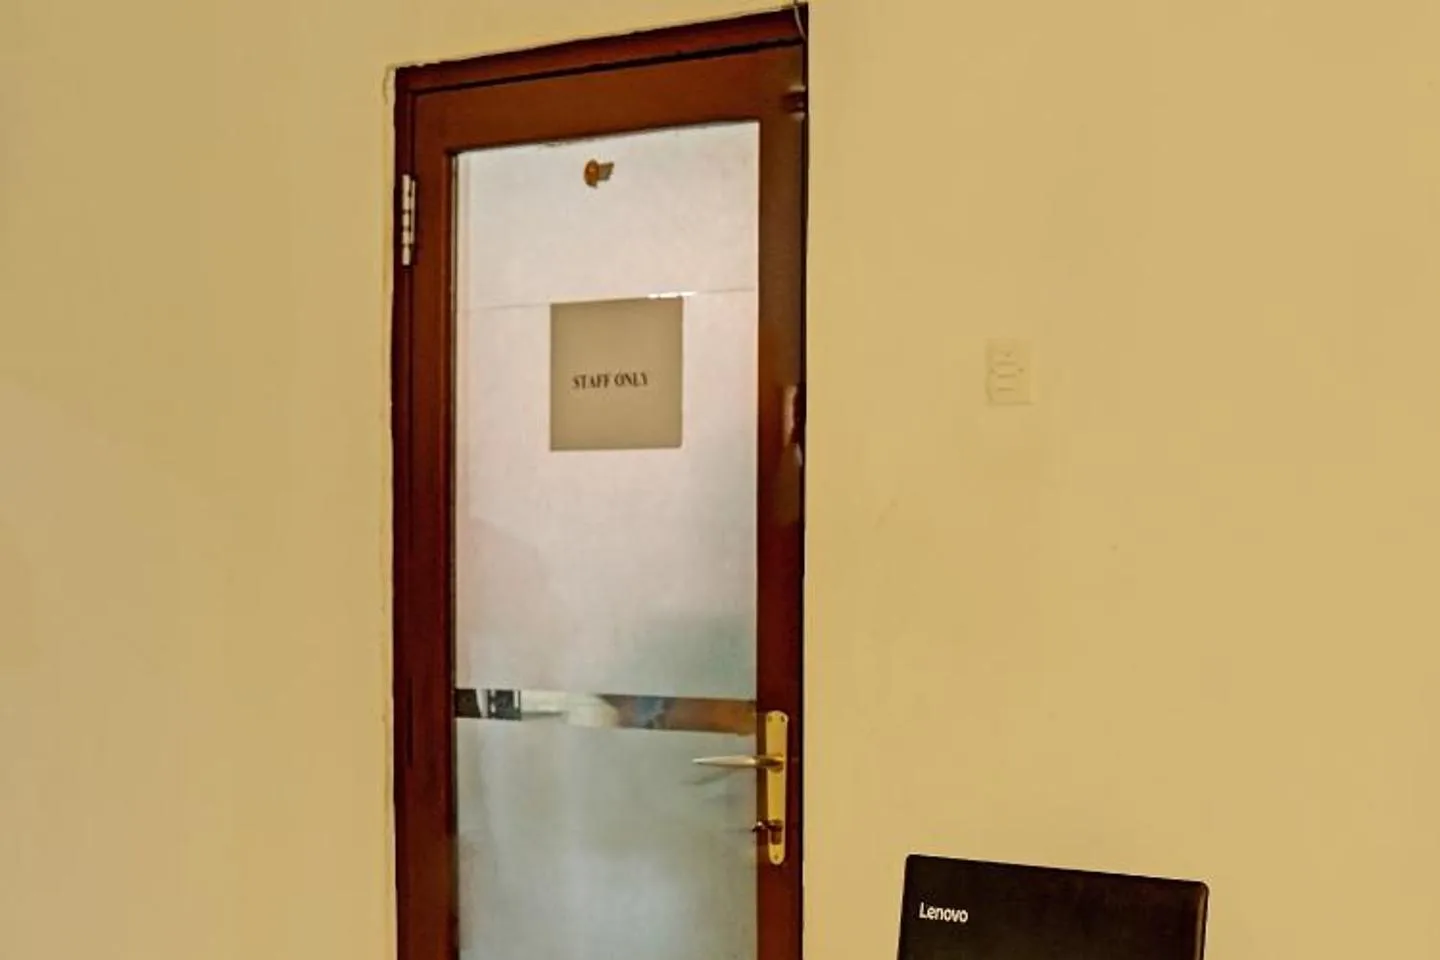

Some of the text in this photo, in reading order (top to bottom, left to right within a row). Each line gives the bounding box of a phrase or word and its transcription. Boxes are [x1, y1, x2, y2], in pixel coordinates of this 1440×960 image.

[571, 371, 649, 389] STAFF ONLY
[919, 901, 969, 923] Lenovo
